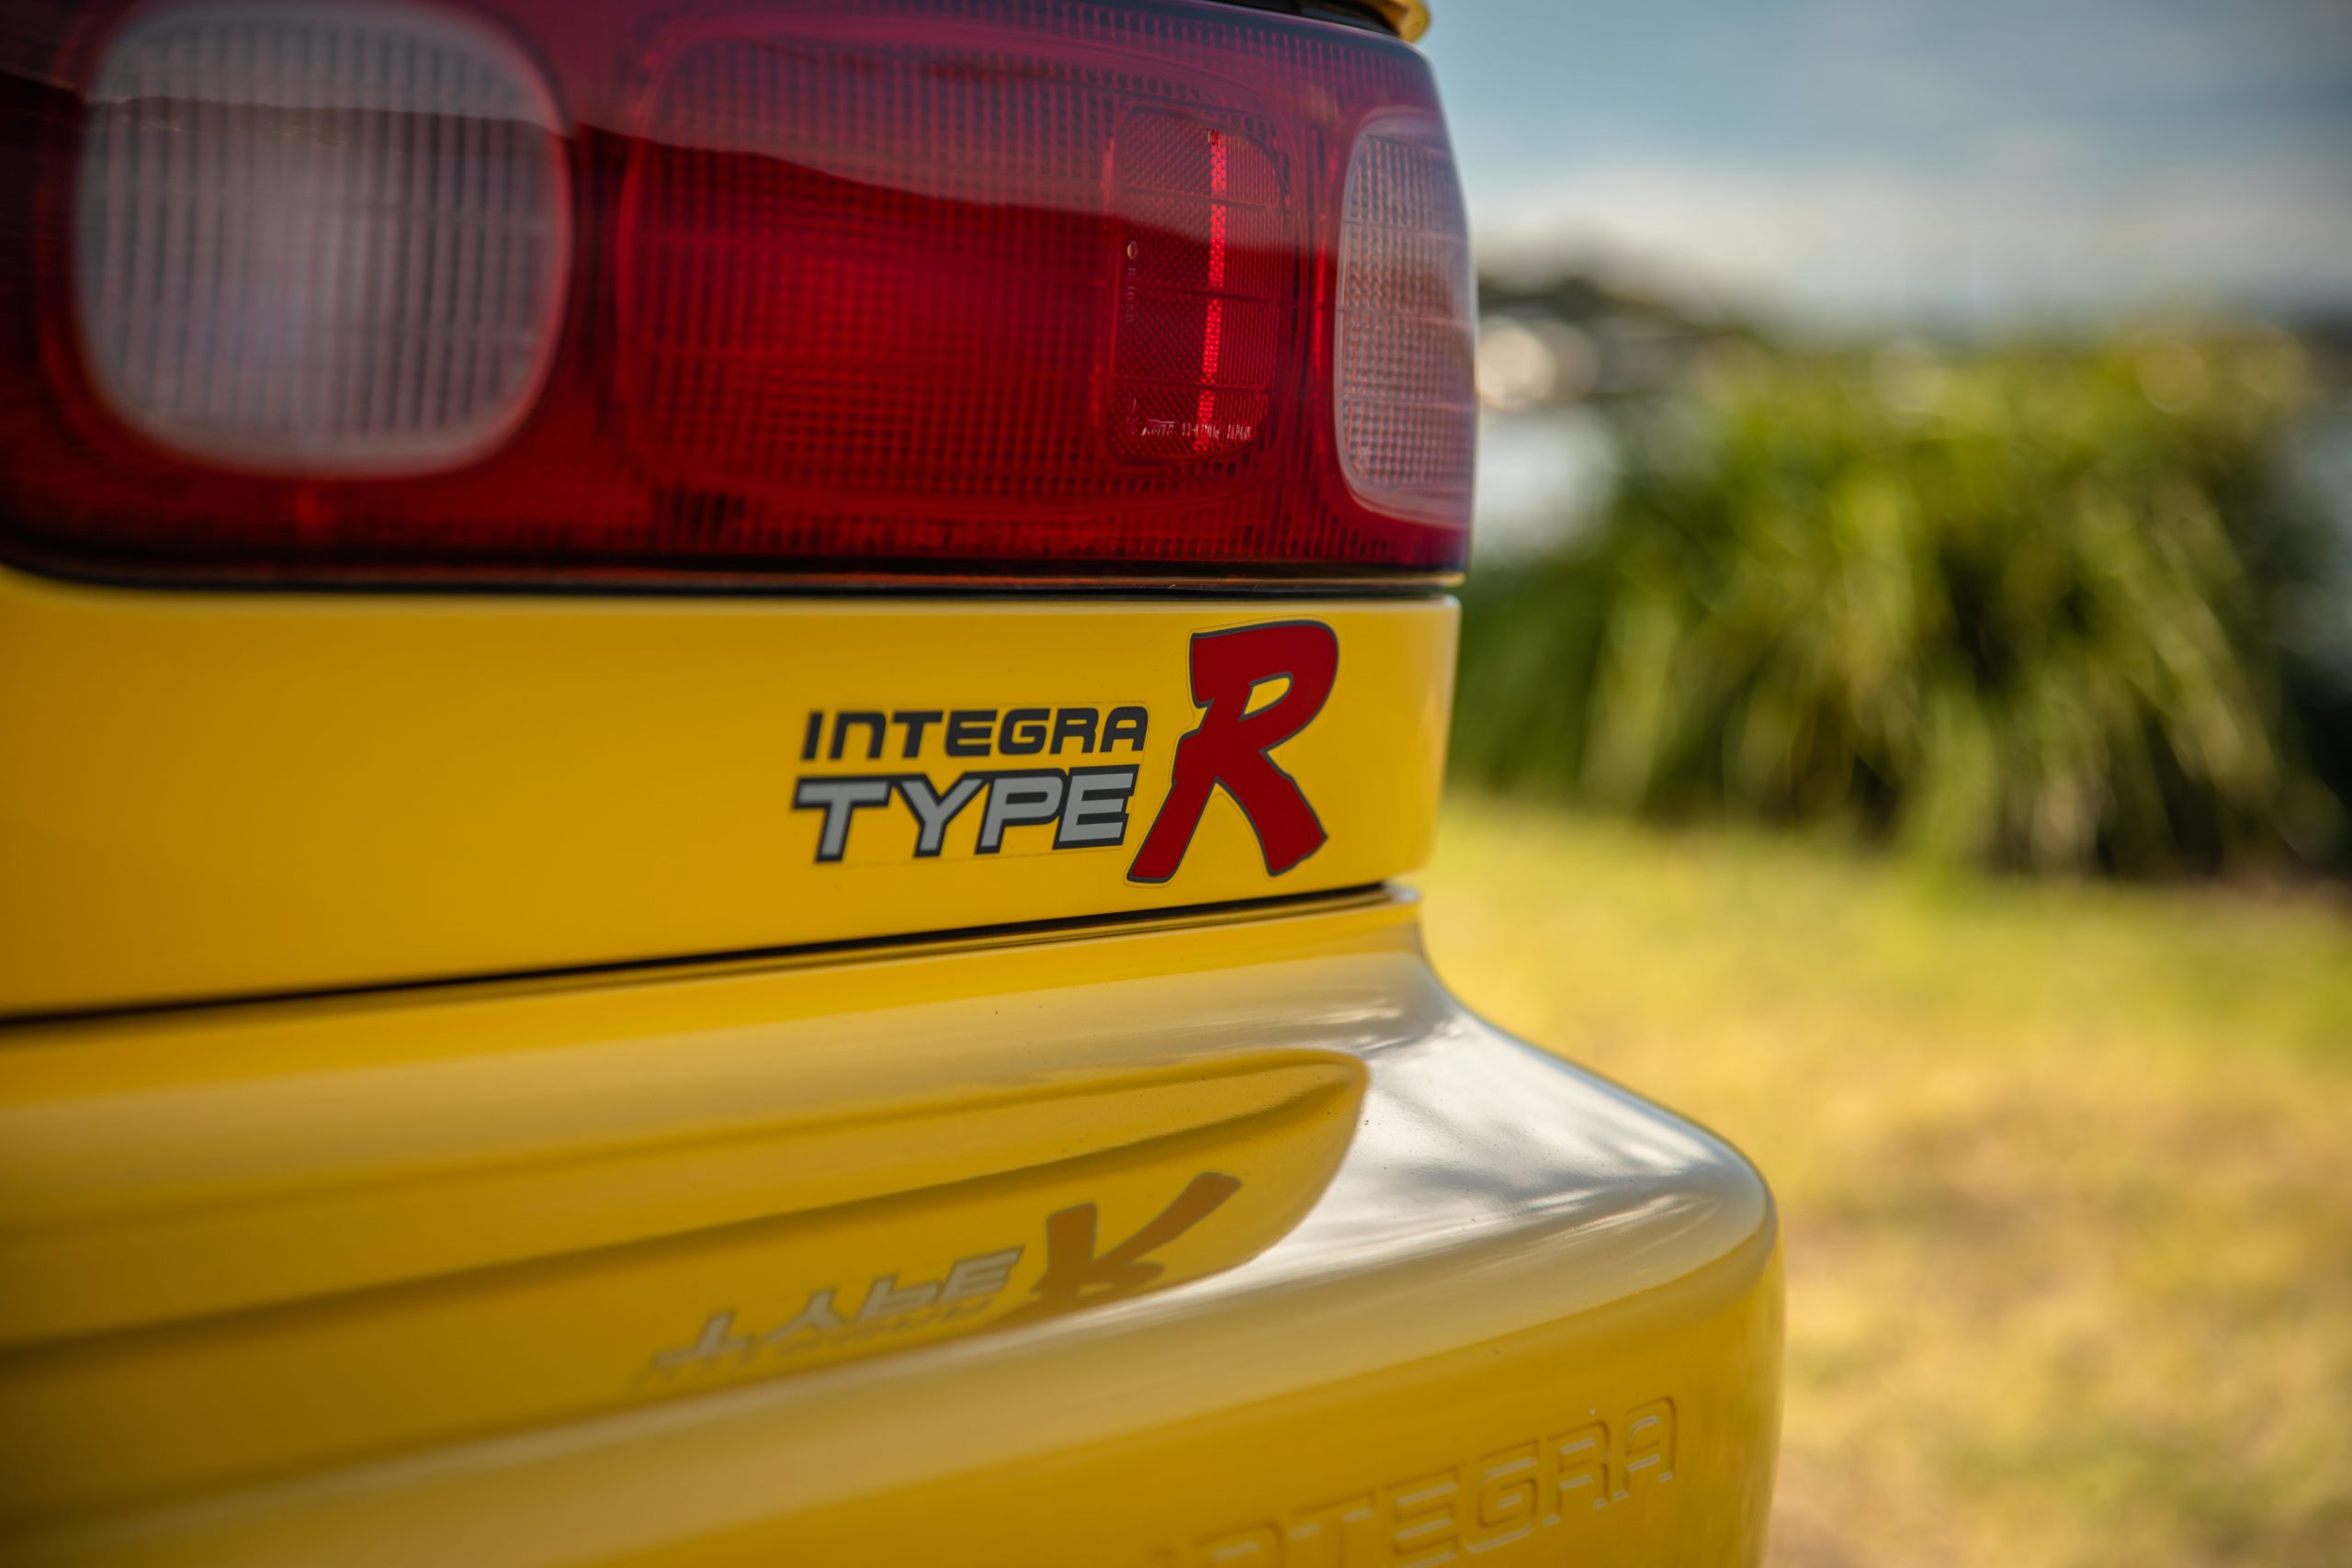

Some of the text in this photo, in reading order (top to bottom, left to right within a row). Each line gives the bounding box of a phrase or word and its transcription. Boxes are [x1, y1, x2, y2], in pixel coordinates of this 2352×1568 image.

[790, 619, 1340, 884] TYPE R
[798, 705, 1149, 761] INTEGRA
[1148, 1394, 1680, 1568] TEGRA
